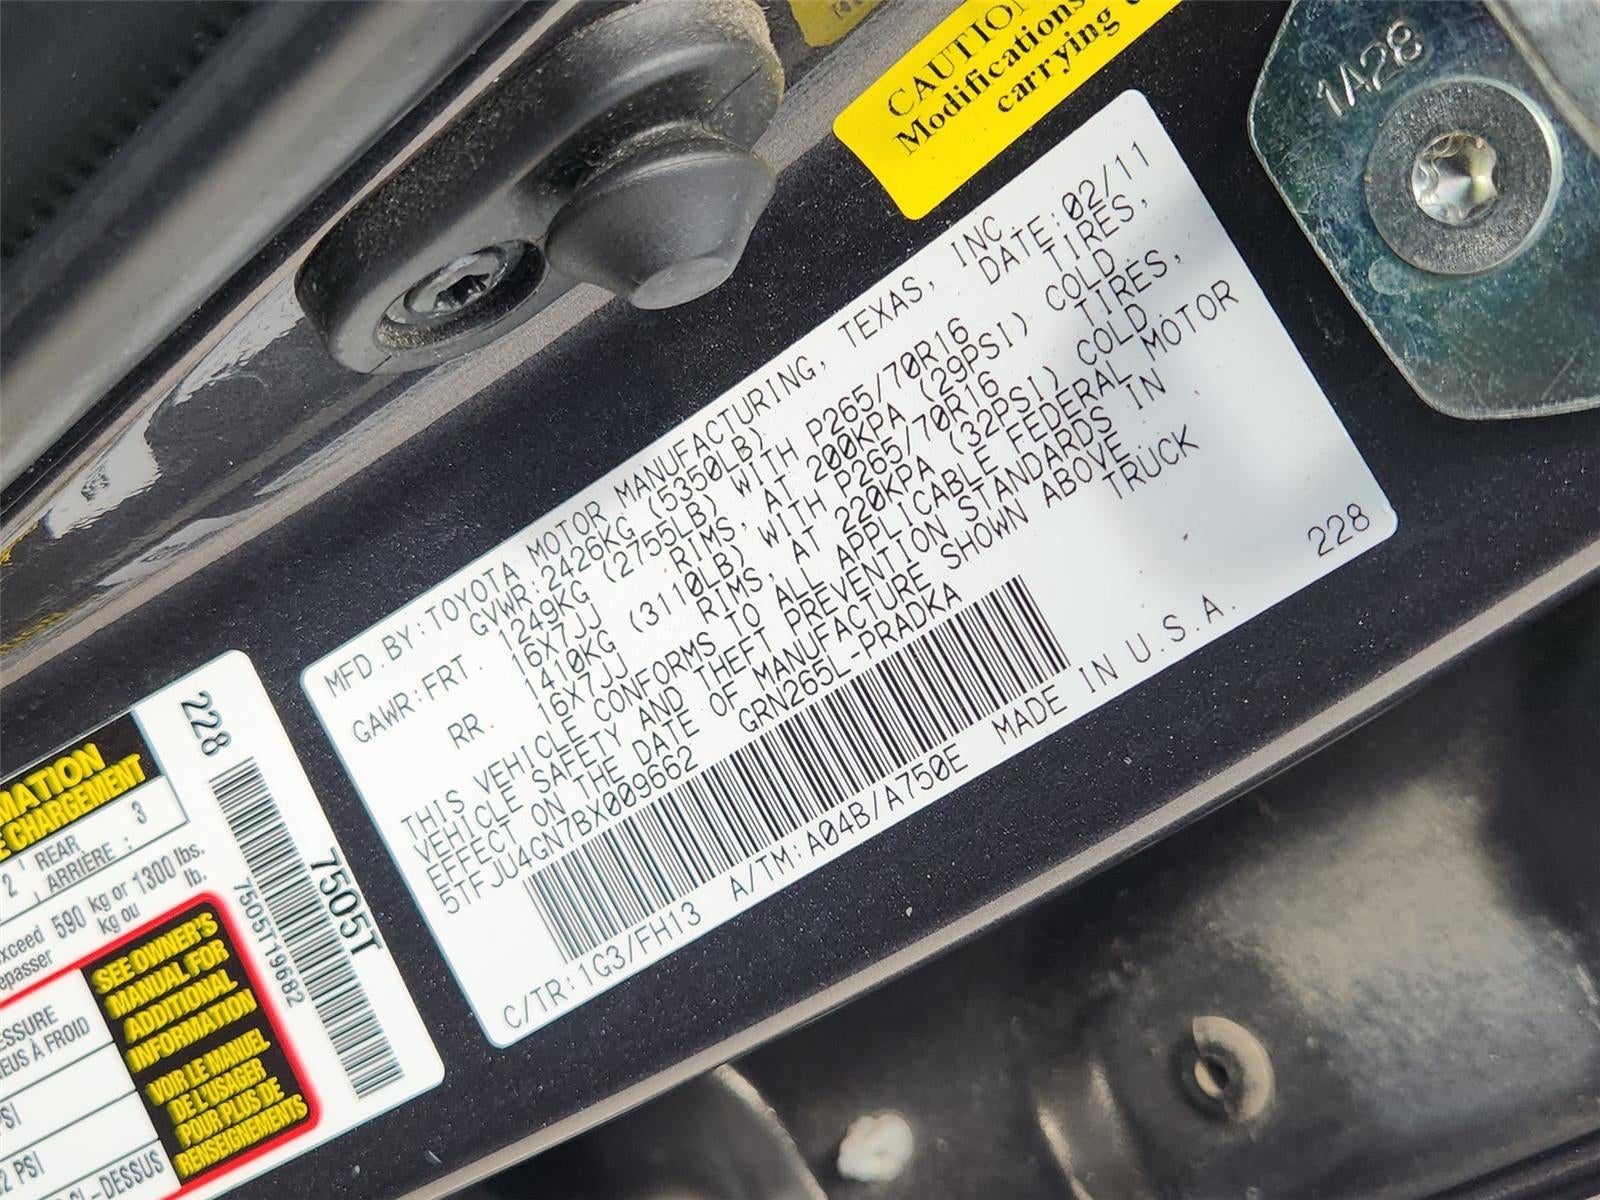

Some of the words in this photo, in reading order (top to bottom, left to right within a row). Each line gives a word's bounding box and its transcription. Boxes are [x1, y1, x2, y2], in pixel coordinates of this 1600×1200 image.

[997, 6, 1120, 113] carrying
[1317, 19, 1423, 117] 1A28
[498, 579, 590, 651] 1249KG
[602, 494, 717, 583] (2755LB)
[729, 436, 800, 498] WITH
[804, 316, 969, 447] P265/70R16
[1041, 193, 1148, 273] TIRES,
[525, 500, 608, 567] MOTOR
[613, 355, 826, 509] MANUFACTURING,
[837, 275, 935, 348] TEXAS,
[950, 215, 1015, 268] INC.
[447, 713, 494, 749] RR.
[524, 629, 617, 700] 1410KG
[629, 544, 745, 633] (3110LB)
[756, 488, 828, 549] WITH
[833, 370, 999, 499] P265/70R16
[1073, 249, 1181, 327] TIRES,
[511, 602, 602, 676] 16X7JJ
[668, 516, 747, 574] RIMS,
[763, 473, 792, 514] AT
[805, 402, 907, 484] 200KPA
[919, 311, 1028, 403] (29PSI)
[1045, 247, 1130, 311] COLD.
[647, 426, 763, 520] (5350LB)
[537, 652, 629, 725] 16X7JJ
[695, 566, 775, 624] RIMS,
[791, 524, 820, 565] AT
[833, 455, 936, 535] 220KPA
[948, 365, 1059, 455] (32PSI)
[1076, 302, 1163, 366] COLD.
[400, 789, 465, 840] THIS
[472, 714, 584, 794] VEHICLE
[593, 631, 716, 722] CONFORMS
[723, 602, 761, 637] TO
[774, 567, 825, 611] ALL
[836, 443, 999, 571] APPLICABLE
[1005, 359, 1133, 455] FEDERAL
[1139, 279, 1239, 362] MOTOR
[413, 784, 524, 863] VEHICLE
[531, 722, 622, 794] SAFETY
[638, 685, 684, 732] AND
[692, 625, 772, 692] THEFT
[783, 513, 949, 637] PREVENTION
[957, 405, 1112, 522] STANDARDS
[1125, 367, 1166, 410] IN
[990, 683, 1068, 745] MADE
[1077, 653, 1119, 694] IN
[1124, 594, 1236, 663] U.S.A.
[1307, 502, 1370, 558] 228
[425, 819, 517, 892] EFFECT
[530, 791, 566, 827] ON
[572, 754, 626, 800] THE
[631, 708, 700, 766] DATE
[708, 679, 738, 717] OF
[751, 560, 932, 691] MANUFACTURE
[939, 497, 1029, 570] SHOWN
[1041, 430, 1142, 509] ABOVE.
[438, 744, 699, 914] 5TFJU4GN7BX009662
[738, 581, 963, 733] GRN265L-PRADKA
[1101, 424, 1200, 500] TRUCK
[181, 690, 232, 757] 228
[3, 753, 146, 851] CHARGEMENT
[131, 800, 147, 825] 3
[2, 872, 18, 898] 2
[34, 834, 81, 871] REAR
[46, 841, 118, 893] ARRIÈRE
[0, 924, 46, 963] xceed
[51, 905, 87, 939] 590
[87, 892, 112, 914] kg
[112, 881, 129, 900] or
[132, 855, 177, 894] 1300
[173, 843, 205, 867] lbs.
[96, 913, 121, 935] kg
[120, 902, 141, 923] ou
[183, 866, 208, 888] lb.
[233, 876, 306, 1008] 7505T19682
[310, 846, 384, 955] 7505T
[91, 956, 136, 994] SEE
[128, 911, 219, 974] OWNER'S
[104, 962, 191, 1020] MANUAL
[183, 939, 230, 977] FOR
[0, 1048, 31, 1079] EUS
[29, 1037, 46, 1062] À
[43, 1016, 91, 1054] FROID
[123, 969, 239, 1044] ADDITIONAL
[125, 988, 257, 1073] INFORMATION
[145, 1069, 189, 1106] VOIR
[183, 1057, 210, 1088] LE
[203, 1028, 272, 1077] MANUEL
[166, 1092, 197, 1125] DE
[191, 1057, 267, 1109] L'USAGER
[0, 1102, 22, 1133] SI
[173, 1093, 309, 1178] RENSEIGNEMENTS
[175, 1108, 224, 1149] POUR
[218, 1088, 262, 1127] PLUS
[256, 1076, 285, 1106] DE
[0, 1169, 13, 1196] 2
[12, 1150, 45, 1185] PSI
